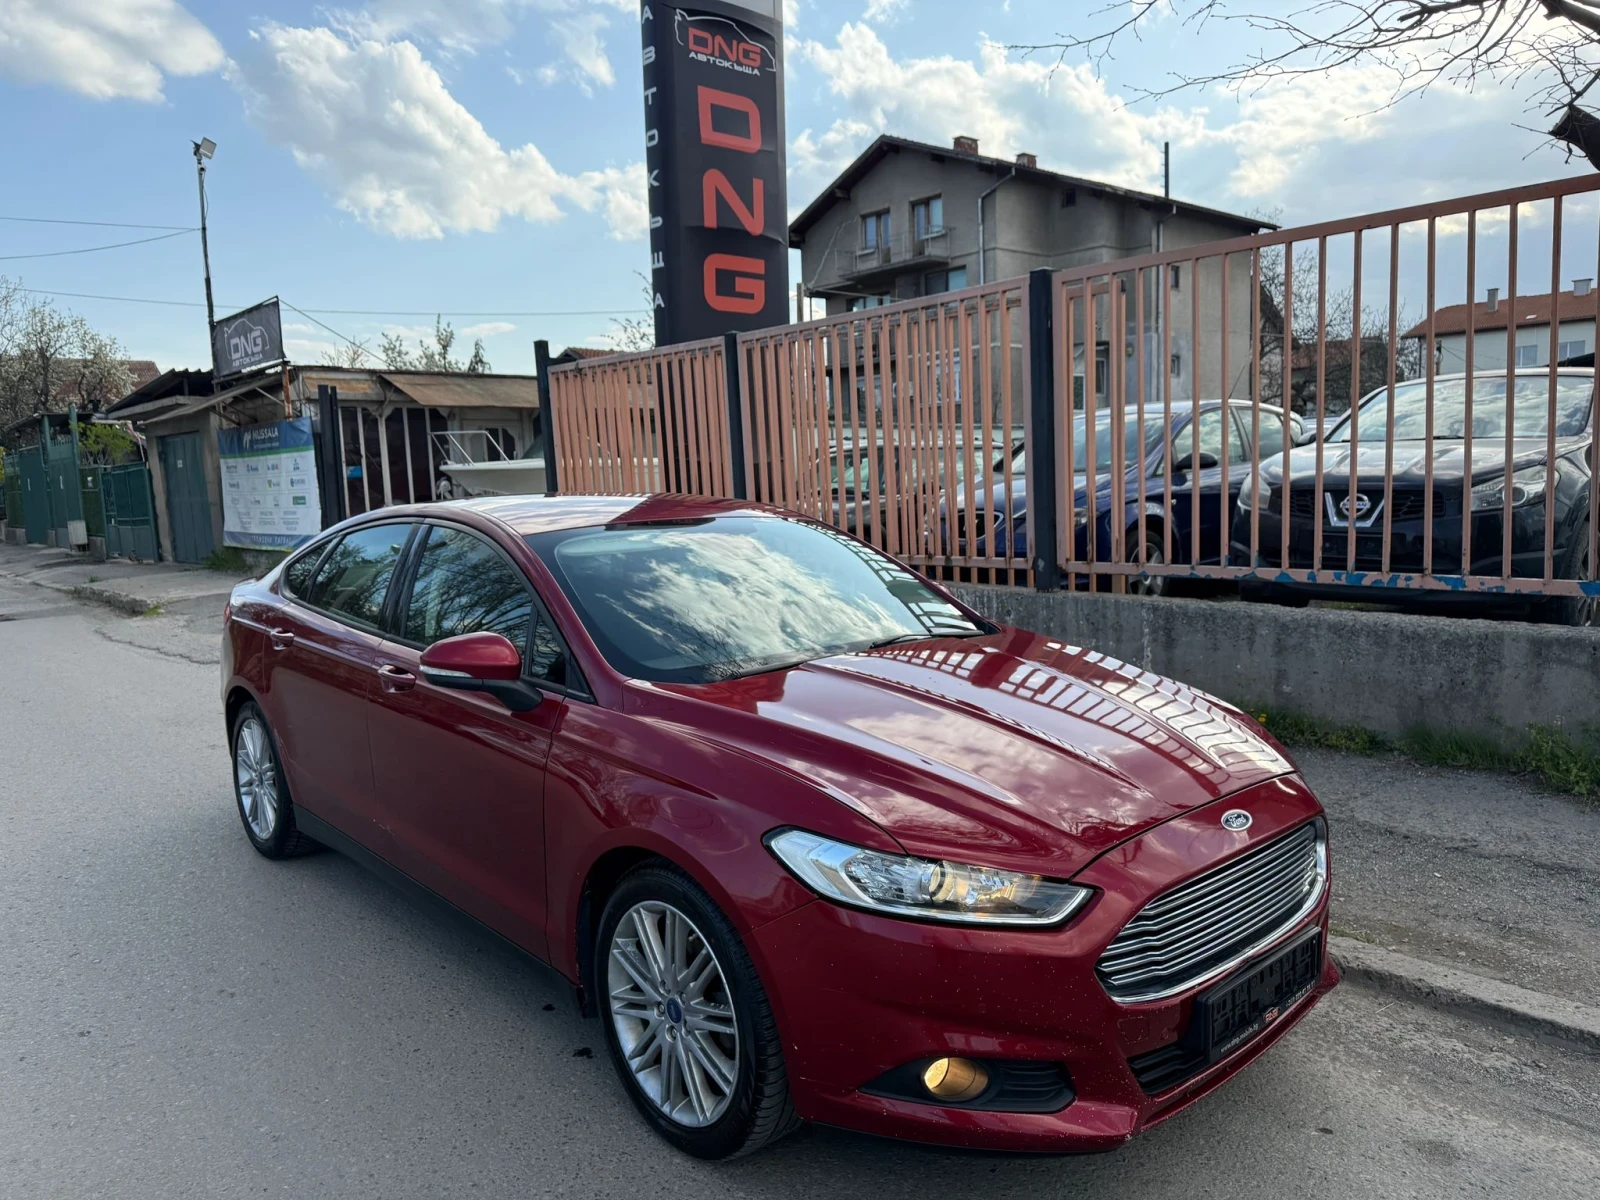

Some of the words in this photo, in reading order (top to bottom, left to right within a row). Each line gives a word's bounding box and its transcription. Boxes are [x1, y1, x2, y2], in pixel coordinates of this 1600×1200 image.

[688, 27, 762, 68] DNG
[688, 51, 761, 76] АВТОКЪША
[697, 85, 766, 315] DNG
[230, 330, 263, 360] DNG
[1227, 813, 1247, 828] Ford
